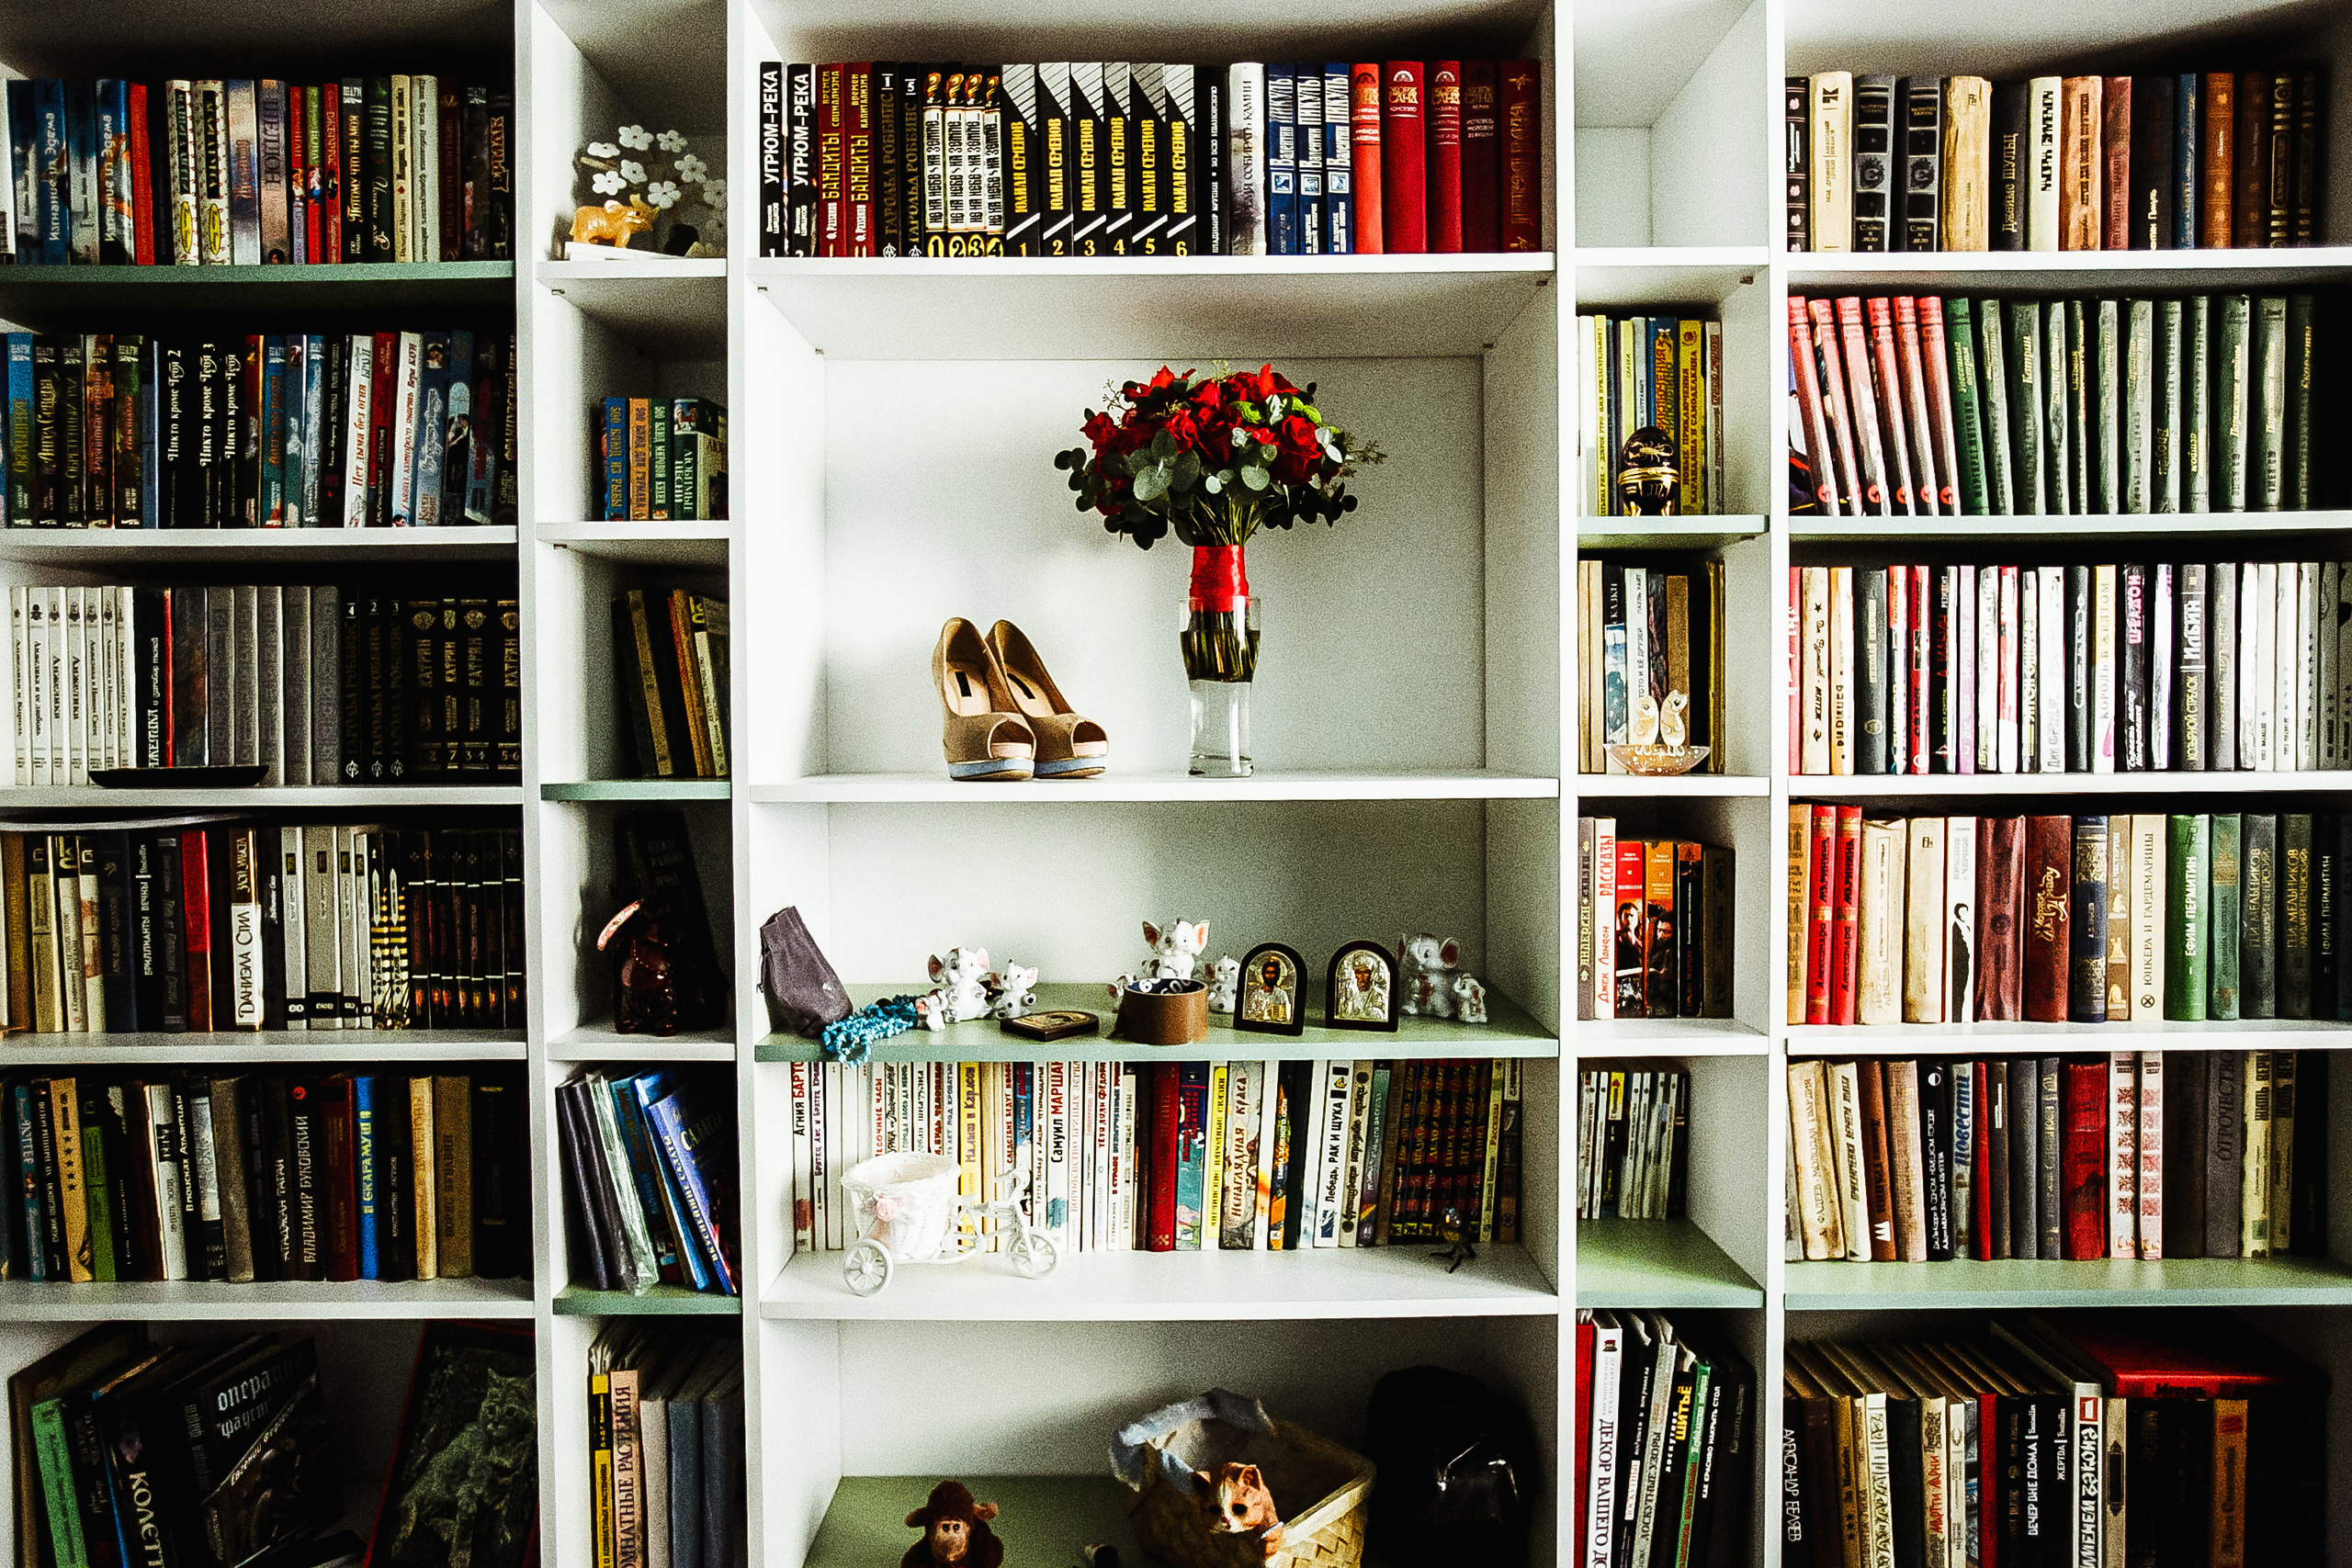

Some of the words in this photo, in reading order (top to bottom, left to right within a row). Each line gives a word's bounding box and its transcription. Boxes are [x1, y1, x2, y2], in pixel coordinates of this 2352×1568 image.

[1241, 81, 1252, 121] КАМНИ
[1269, 78, 1294, 124] ПИКУЛЬ
[1297, 79, 1321, 126] ПИКУЛЬ
[1325, 79, 1350, 124] ПИКУЛЬ
[1388, 94, 1419, 105] САНД
[1431, 94, 1461, 105] САНД
[349, 115, 359, 136] моя
[1012, 121, 1027, 171] СЕМЕНОВ
[1048, 118, 1063, 167] СЕМЕНОВ
[1080, 119, 1094, 168] СЕМЕНОВ
[1111, 118, 1125, 166] СЕМЕНОВ
[1141, 119, 1155, 168] СЕМЕНОВ
[1171, 121, 1185, 171] СЕМЕНОВ
[351, 157, 361, 175] что
[822, 132, 842, 199] БАНДИТЫ
[1242, 122, 1253, 181] СОБИРАТЬ
[1270, 127, 1295, 166] Валентин
[1299, 128, 1323, 169] Валентин
[1327, 126, 1351, 167] Валентин
[2002, 133, 2019, 181] ШУЛЬЦ
[851, 135, 870, 202] БАНДИТЫ
[1050, 168, 1064, 210] ЮЛИАН
[1112, 168, 1125, 209] ЮЛИАН
[346, 177, 364, 221] Потому
[1013, 172, 1028, 213] ЮЛИАН
[1081, 170, 1095, 211] ЮЛИАН
[1142, 170, 1156, 211] ЮЛИАН
[1173, 172, 1187, 214] ЮЛИАН
[2001, 184, 2018, 233] Джеймс
[2147, 188, 2159, 220] Пикуль
[932, 238, 943, 257] 1
[953, 239, 965, 257] 2
[969, 237, 983, 257] 3
[988, 241, 1002, 257] 4
[1020, 242, 1028, 257] 1
[1052, 239, 1063, 256] 2
[1084, 239, 1095, 257] 3
[1114, 239, 1125, 255] 4
[1146, 237, 1156, 255] 5
[1176, 240, 1186, 257] 6
[168, 349, 182, 358] 2
[203, 343, 217, 352] 3
[224, 354, 242, 381] Тебя
[2021, 334, 2035, 384] Катрин
[167, 362, 186, 388] Тебя
[199, 355, 218, 383] Тебя
[1689, 350, 1698, 426] САМОДЕЛКИНА
[170, 389, 183, 420] кроме
[202, 386, 215, 420] кроме
[227, 383, 238, 416] кроме
[1681, 367, 1690, 446] ПРИКЛЮЧЕНИЯ
[167, 423, 180, 461] Никто
[198, 425, 212, 468] Никто
[224, 420, 237, 459] Никто
[674, 460, 684, 503] ПЕСНИ
[684, 448, 695, 513] ЛЮБИМЫЕ
[1681, 450, 1690, 486] НОВЫЕ
[1690, 439, 1698, 504] КАРАНДАША
[2099, 581, 2109, 646] ЖЕЛТОМ
[2129, 574, 2143, 644] ШЕЛДОН
[416, 638, 434, 688] КАТРИН
[444, 641, 458, 682] КАТРИН
[467, 637, 483, 687] КАТРИН
[503, 638, 519, 688] КАТРИН
[52, 655, 62, 720] Анжелика
[72, 656, 81, 720] Анжелика
[2099, 663, 2109, 720] КОРОЛЬ
[2187, 675, 2199, 714] СТРЕЛОК
[2186, 714, 2199, 761] КОЗЫРНОЙ
[1581, 855, 1590, 899] СКАЗКИ
[1599, 835, 1614, 897] РАССКАЗЫ
[2143, 832, 2154, 918] ГАРДЕМАРИНЫ
[2287, 848, 2299, 922] МЕЛЬНИКОВ
[2321, 855, 2333, 918] ПЕРМИТИН
[141, 881, 151, 911] ВЕЧНЫ
[2185, 855, 2198, 919] ПЕРМИТИН
[142, 917, 153, 976] БРИЛЛИАНТЫ
[236, 910, 253, 946] СТИЛ
[1580, 906, 1592, 968] АНДЕРСЕН
[1598, 925, 1611, 965] Лондон
[2185, 921, 2197, 957] ЕФИМ
[2287, 924, 2299, 948] П.И.
[2323, 921, 2333, 955] ЕФИМ
[2143, 937, 2154, 986] ЮНКЕРА
[238, 952, 254, 1019] ДАНИЭЛА
[1597, 972, 1611, 1004] Джек
[964, 1066, 979, 1110] Карлсон
[2255, 1053, 2270, 1082] ВЕРН
[874, 1077, 883, 1104] ЧАСЫ
[1216, 1077, 1226, 1113] СКАЗКИ
[1234, 1077, 1248, 1116] КРАСА
[2254, 1087, 2270, 1122] ЖЮЛЬ
[792, 1101, 806, 1136] Агния
[1329, 1101, 1344, 1132] ЩУКА
[1954, 1074, 1972, 1167] Повести
[295, 1115, 312, 1189] БУКОВСКИЙ
[662, 1134, 688, 1182] САЛАТЫ
[964, 1122, 976, 1163] Малыш
[1050, 1118, 1064, 1164] Самуил
[1329, 1133, 1341, 1142] И
[1329, 1143, 1341, 1164] РАК
[359, 1122, 374, 1201] СКАРАМУШ
[1230, 1127, 1248, 1218] НЕНАГЛЯДНАЯ
[1325, 1167, 1340, 1203] Лебедь,
[278, 1199, 290, 1262] АТАДЖАН
[300, 1191, 317, 1263] ВЛАДИМИР
[682, 1183, 719, 1262] ВКУСНЕЙШИЕ
[1673, 1384, 1692, 1441] ШИТЬЁ
[1713, 1385, 1722, 1407] СТОЛ
[614, 1384, 635, 1472] РАСТЕНИЯ
[1597, 1418, 1614, 1469] ДЕКОР
[1707, 1408, 1719, 1445] НАКРЫТЬ
[1647, 1431, 1662, 1471] УЗОРЫ
[1702, 1445, 1714, 1483] КРАСИВО
[1782, 1427, 1801, 1496] АЛЕКСАНДР
[2026, 1441, 2039, 1480] ДОМА
[2056, 1444, 2067, 1482] ЖЕРТВА
[2080, 1426, 2099, 1497] ЗАКОНА
[1595, 1475, 1611, 1547] ВАШЕГО
[1640, 1472, 1657, 1541] ЛОСКУТНЫЕ
[1702, 1483, 1711, 1499] КАК
[2027, 1481, 2039, 1503] ВНЕ
[616, 1478, 637, 1568] ОМНАТНЫЕ
[1784, 1500, 1803, 1542] БЕЛЯЕВ
[1929, 1493, 1944, 1534] МАРТТИ
[2027, 1503, 2040, 1537] ВЕЧЕР
